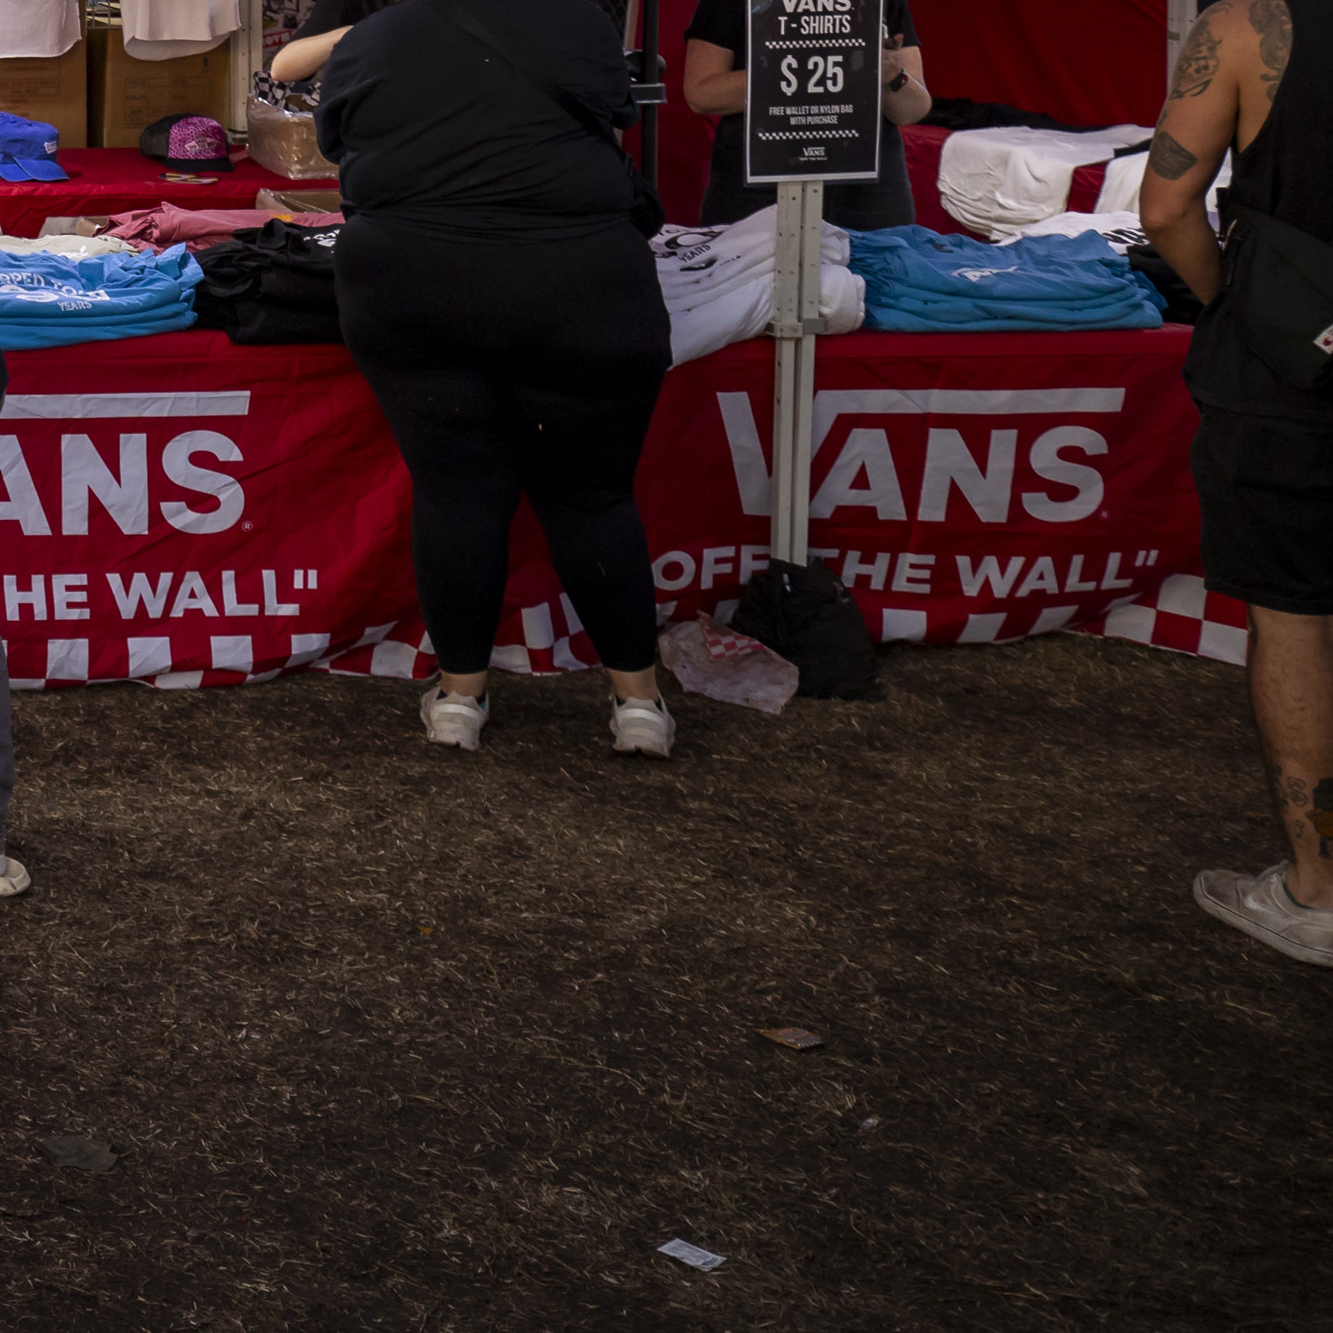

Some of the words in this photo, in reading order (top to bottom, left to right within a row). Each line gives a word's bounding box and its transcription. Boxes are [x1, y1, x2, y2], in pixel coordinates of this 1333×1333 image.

[778, 16, 788, 35] T
[801, 15, 851, 35] SHIRTS
[781, 55, 798, 96] $
[807, 56, 844, 93] 25
[769, 107, 785, 116] FREE
[786, 106, 809, 115] WALLET
[810, 106, 819, 114] OR
[820, 105, 840, 114] NYLON
[840, 105, 853, 113] BAG
[790, 117, 806, 125] WITH
[807, 116, 838, 124] PURCHASE
[803, 147, 825, 156] VANS
[58, 300, 92, 312] YEARS
[717, 387, 1126, 523] VANS
[956, 550, 1159, 599] WALL"
[105, 569, 319, 620] WALL"
